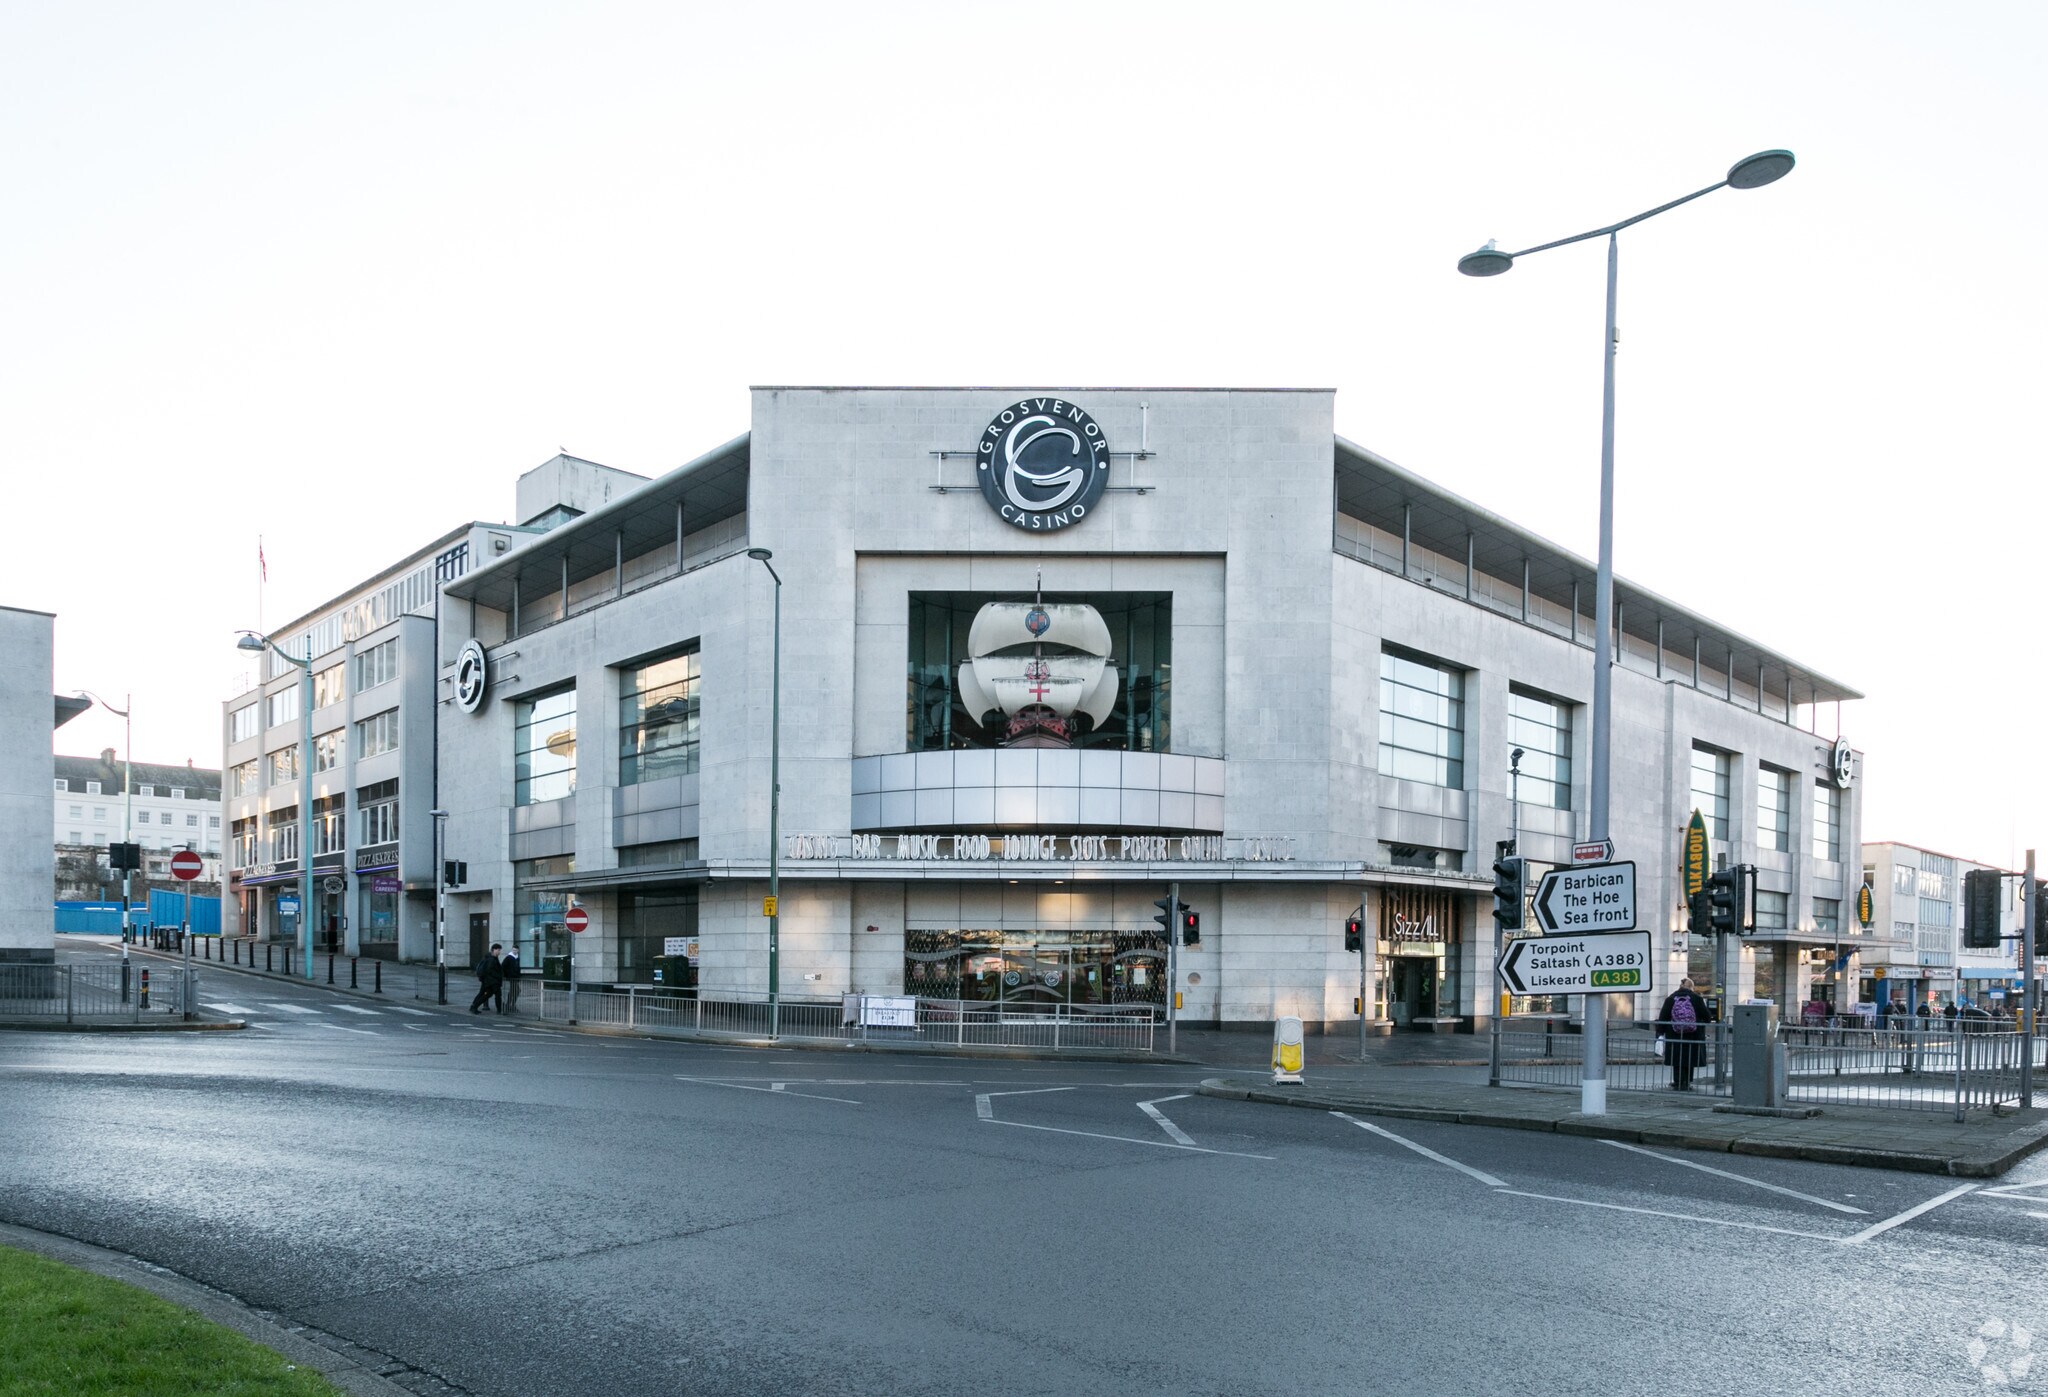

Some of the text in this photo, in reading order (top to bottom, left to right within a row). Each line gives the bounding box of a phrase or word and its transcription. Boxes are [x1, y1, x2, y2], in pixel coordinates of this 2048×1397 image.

[979, 398, 1106, 454] GROSVENOR
[1001, 504, 1085, 528] CASINO
[852, 834, 881, 859] BAR
[897, 834, 941, 860] MUSIC
[954, 834, 990, 860] FOOD
[1004, 835, 1057, 860] LOUNGE
[1069, 835, 1107, 860] SLOTS
[1121, 835, 1167, 861] POKER
[1689, 827, 1703, 894] ALKABOUT
[1564, 873, 1624, 890] Barbican
[1563, 891, 1620, 907] The Hoe
[1563, 907, 1629, 925] Sea front
[1530, 942, 1585, 955] Torpoint
[1530, 952, 1644, 969] Saltash (A388)
[1531, 970, 1639, 986] Liskeard (A38)
